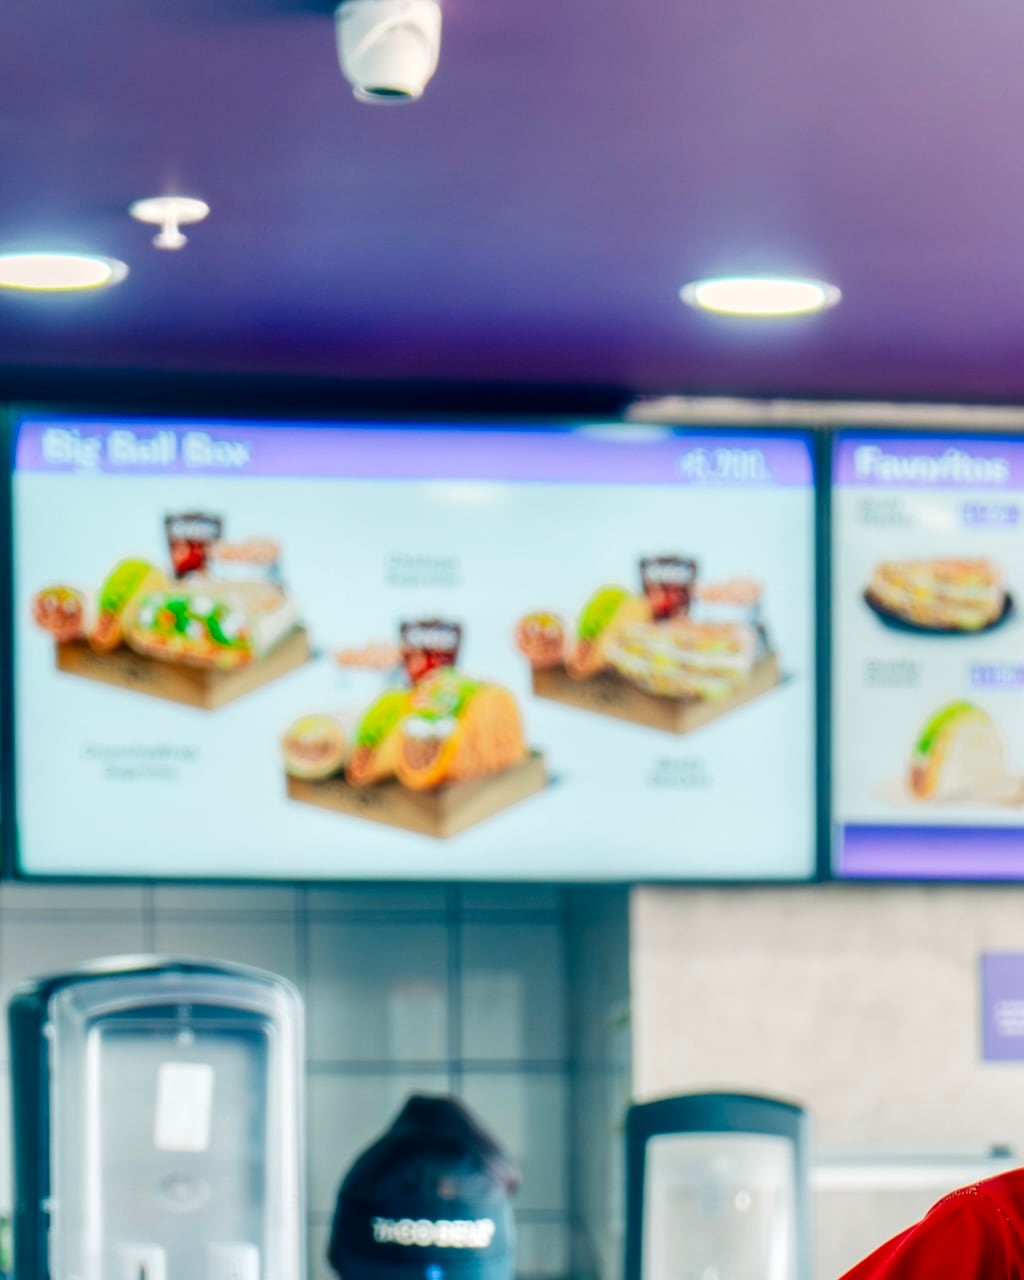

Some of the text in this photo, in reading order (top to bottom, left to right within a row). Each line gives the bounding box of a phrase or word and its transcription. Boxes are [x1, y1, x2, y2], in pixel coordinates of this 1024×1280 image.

[43, 428, 99, 470] Big
[182, 432, 248, 467] Box
[854, 445, 1009, 483] Favoritos
